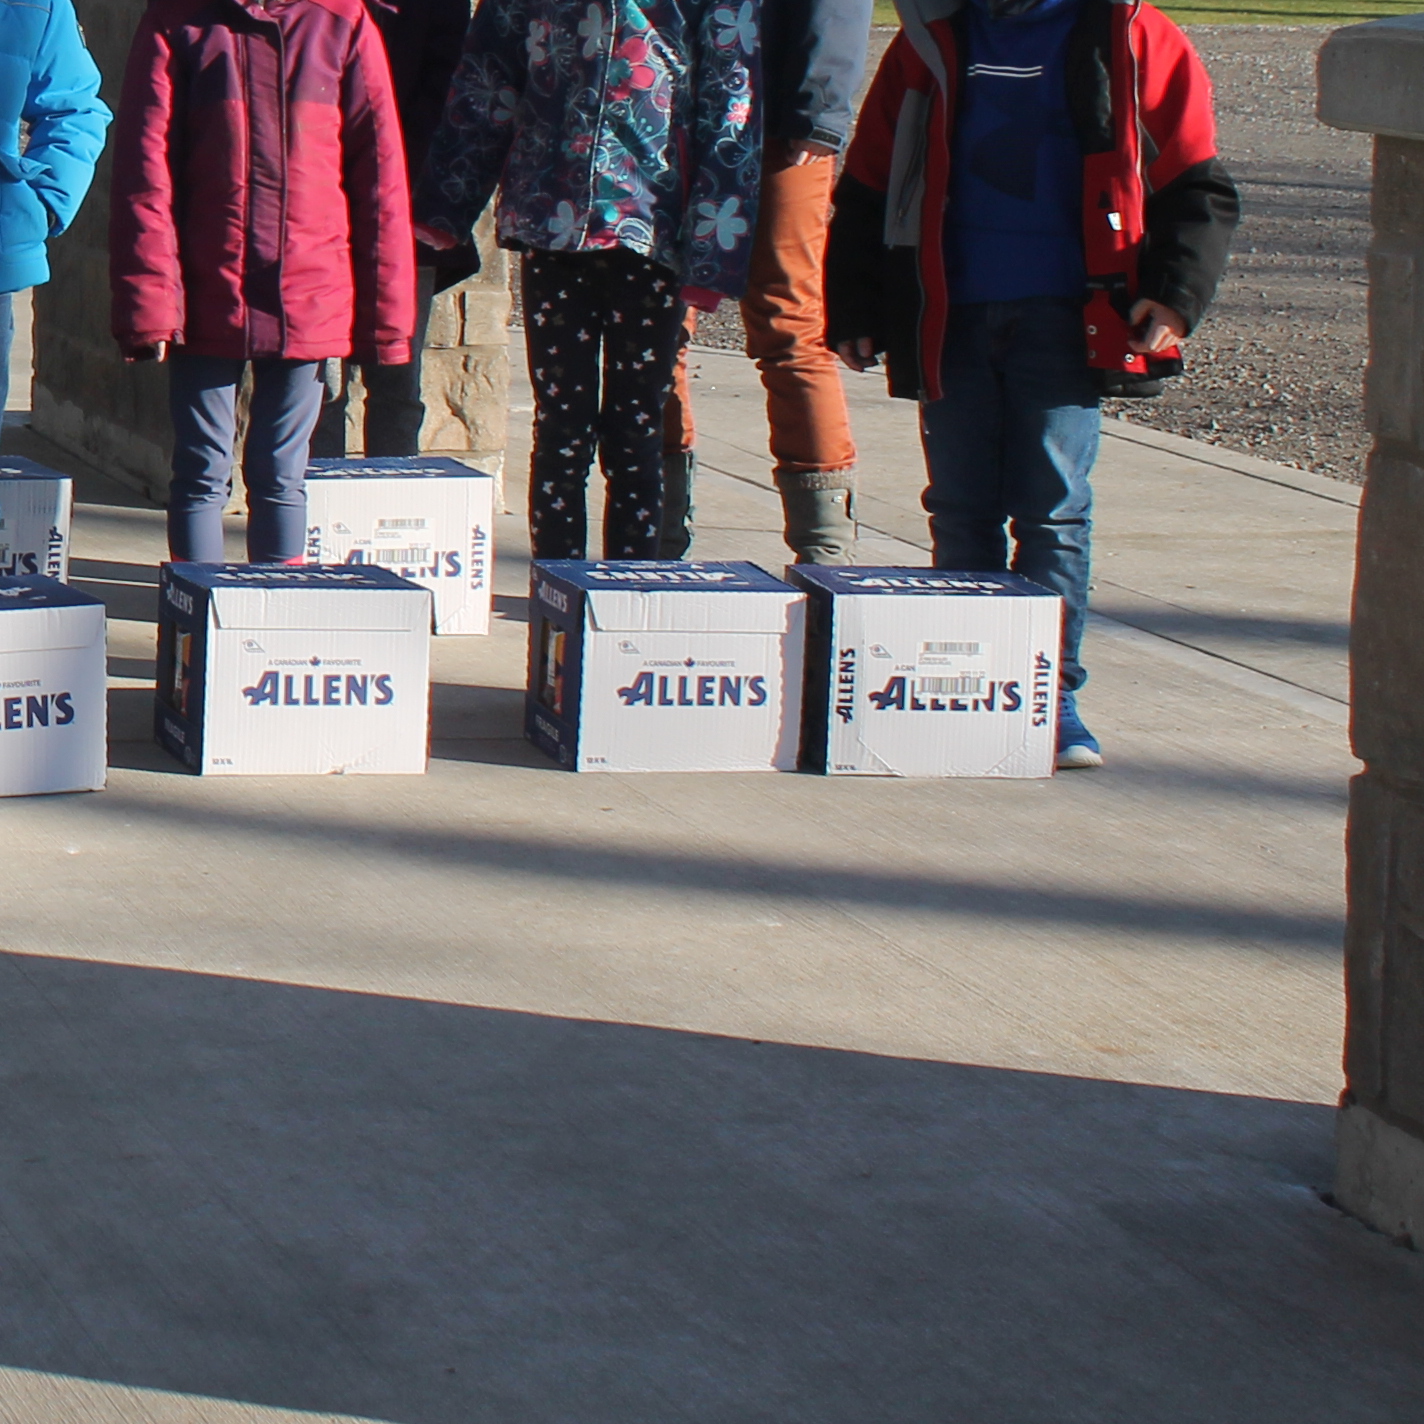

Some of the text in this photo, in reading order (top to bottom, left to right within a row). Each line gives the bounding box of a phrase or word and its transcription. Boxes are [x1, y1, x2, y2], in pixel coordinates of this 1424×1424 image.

[307, 526, 321, 564] LEN'S
[471, 524, 486, 590] ALLEN'S
[2, 680, 41, 689] FAVOURITE
[242, 671, 394, 706] ALLEN'S
[616, 672, 768, 706] ALLEN'S
[836, 648, 855, 724] ALLEN'S
[1032, 651, 1051, 727] ALLEN'S
